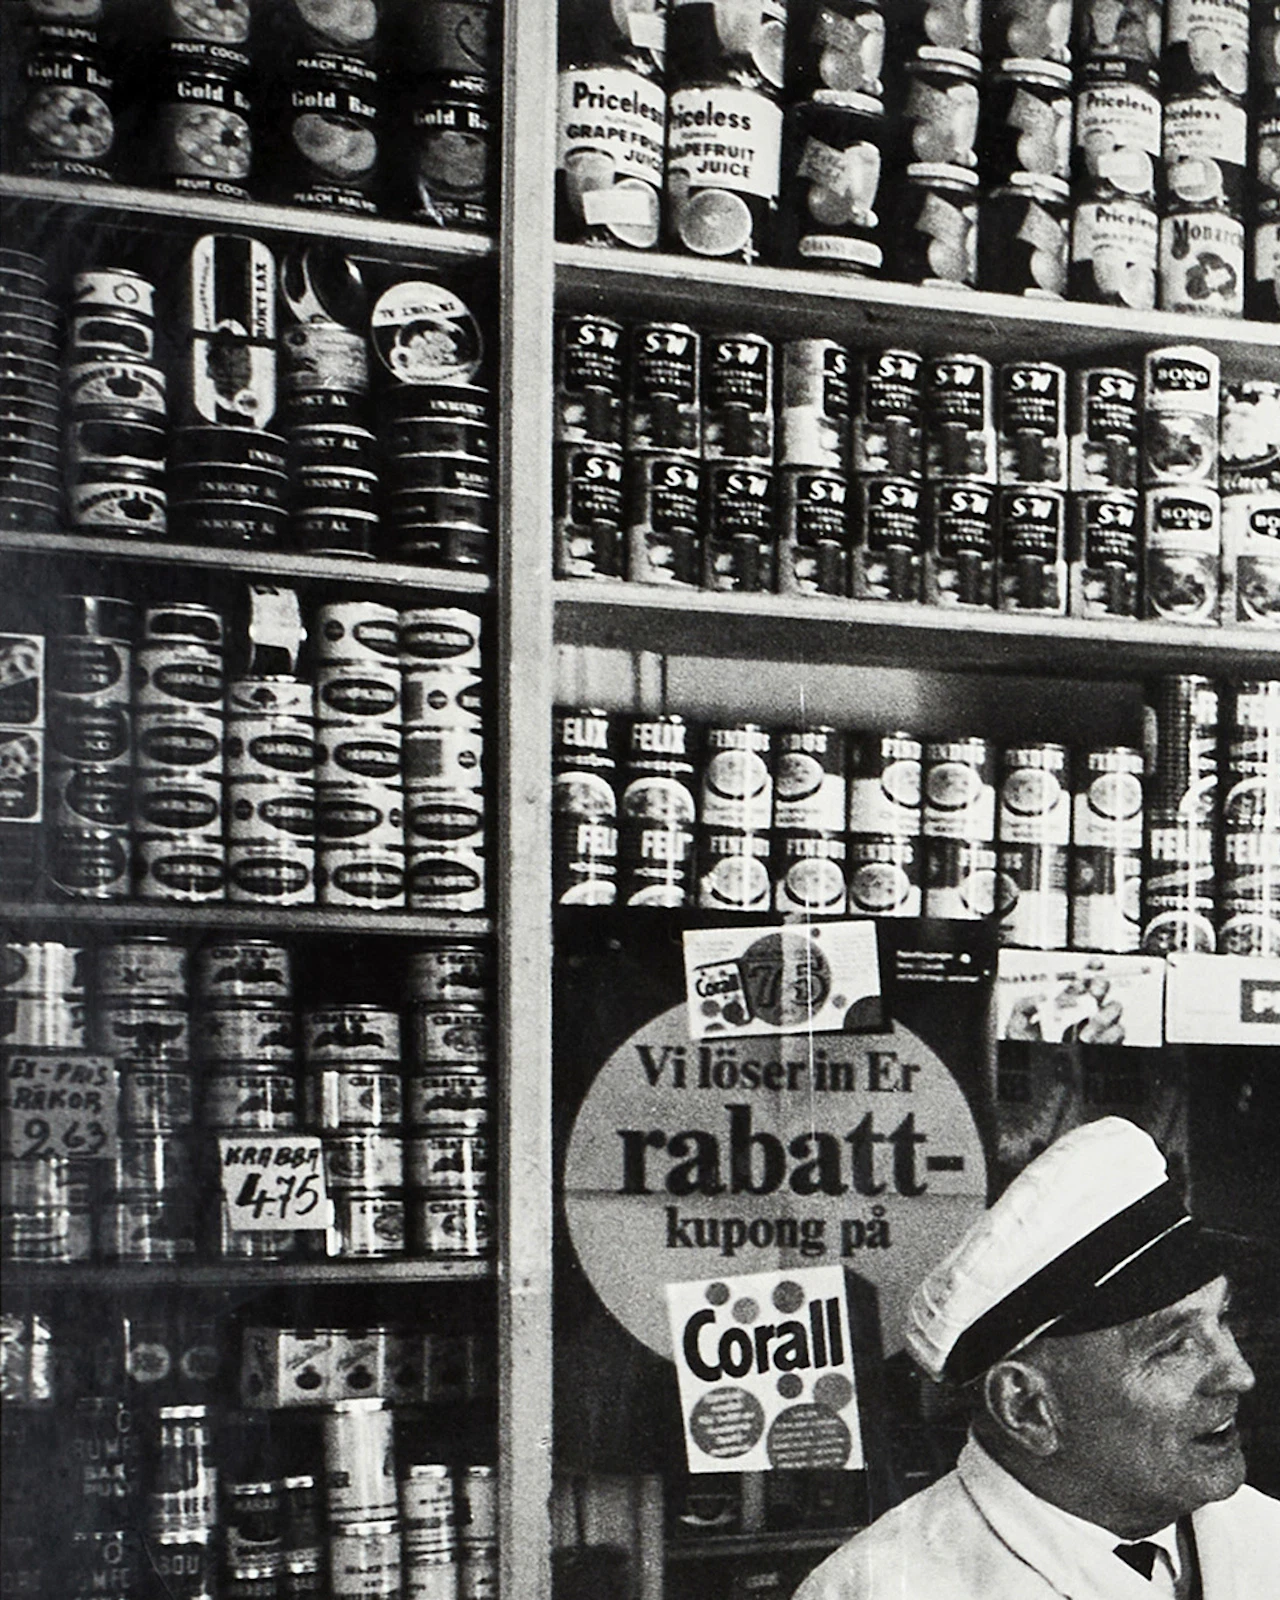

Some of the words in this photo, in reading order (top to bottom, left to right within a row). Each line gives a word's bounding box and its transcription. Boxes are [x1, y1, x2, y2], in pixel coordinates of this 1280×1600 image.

[177, 80, 225, 102] Gold
[291, 90, 337, 109] Gold
[696, 159, 752, 179] JUICE
[635, 1044, 688, 1092] Vi
[697, 1044, 808, 1094] löser
[814, 1048, 857, 1092] in
[866, 1050, 922, 1095] Er
[225, 1145, 321, 1171] KRABBA
[616, 1104, 966, 1198] rabatt-
[235, 1172, 321, 1220] 4.75
[665, 1206, 826, 1257] kupong
[840, 1205, 892, 1257] på
[682, 1296, 846, 1383] Corall
